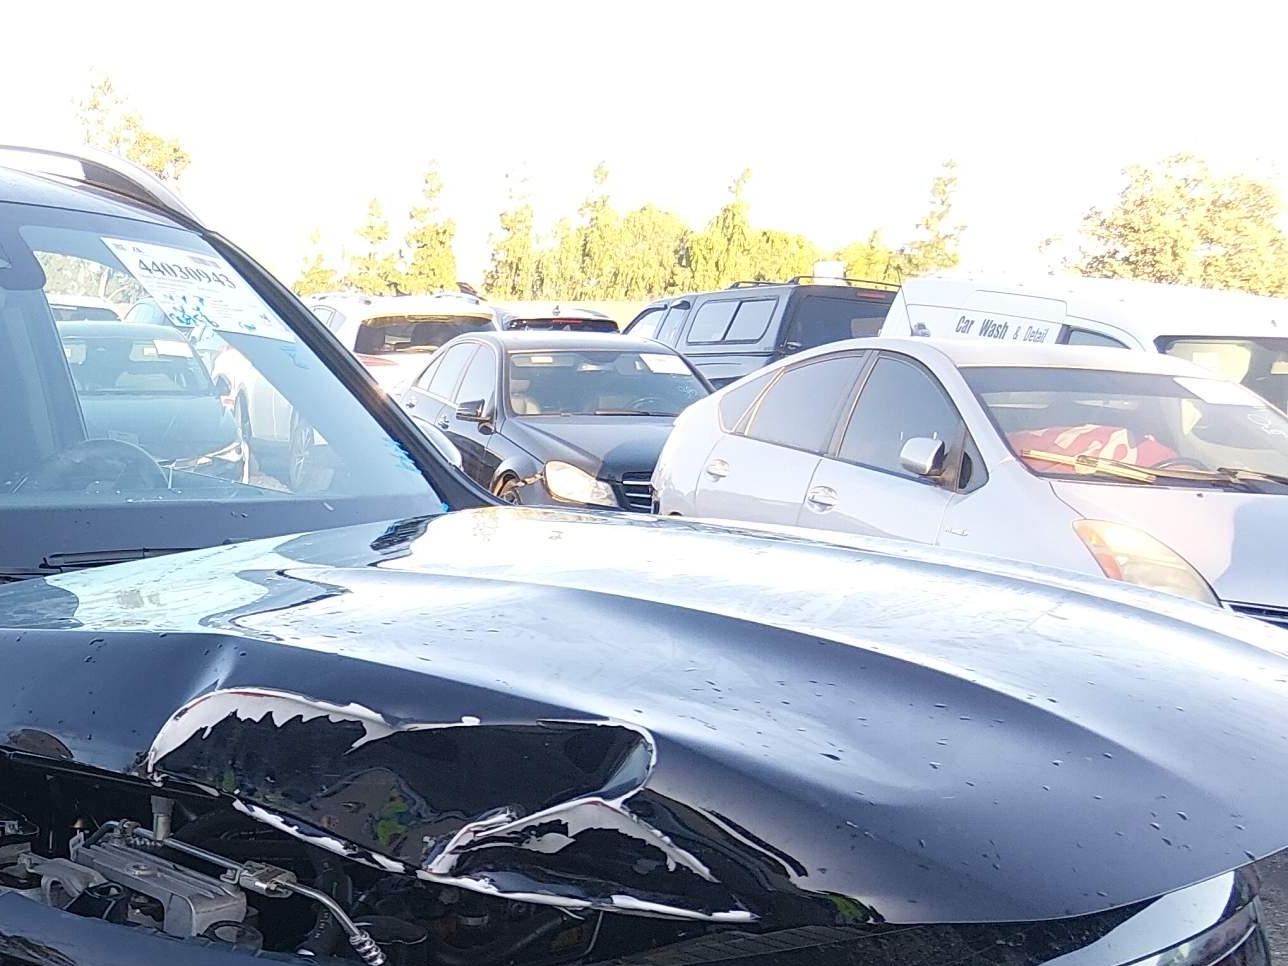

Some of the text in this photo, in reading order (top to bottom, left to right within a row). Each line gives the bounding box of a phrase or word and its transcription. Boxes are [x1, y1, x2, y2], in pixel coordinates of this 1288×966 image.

[138, 259, 236, 288] 44030943
[955, 315, 1049, 343] Car Wash & Detail
